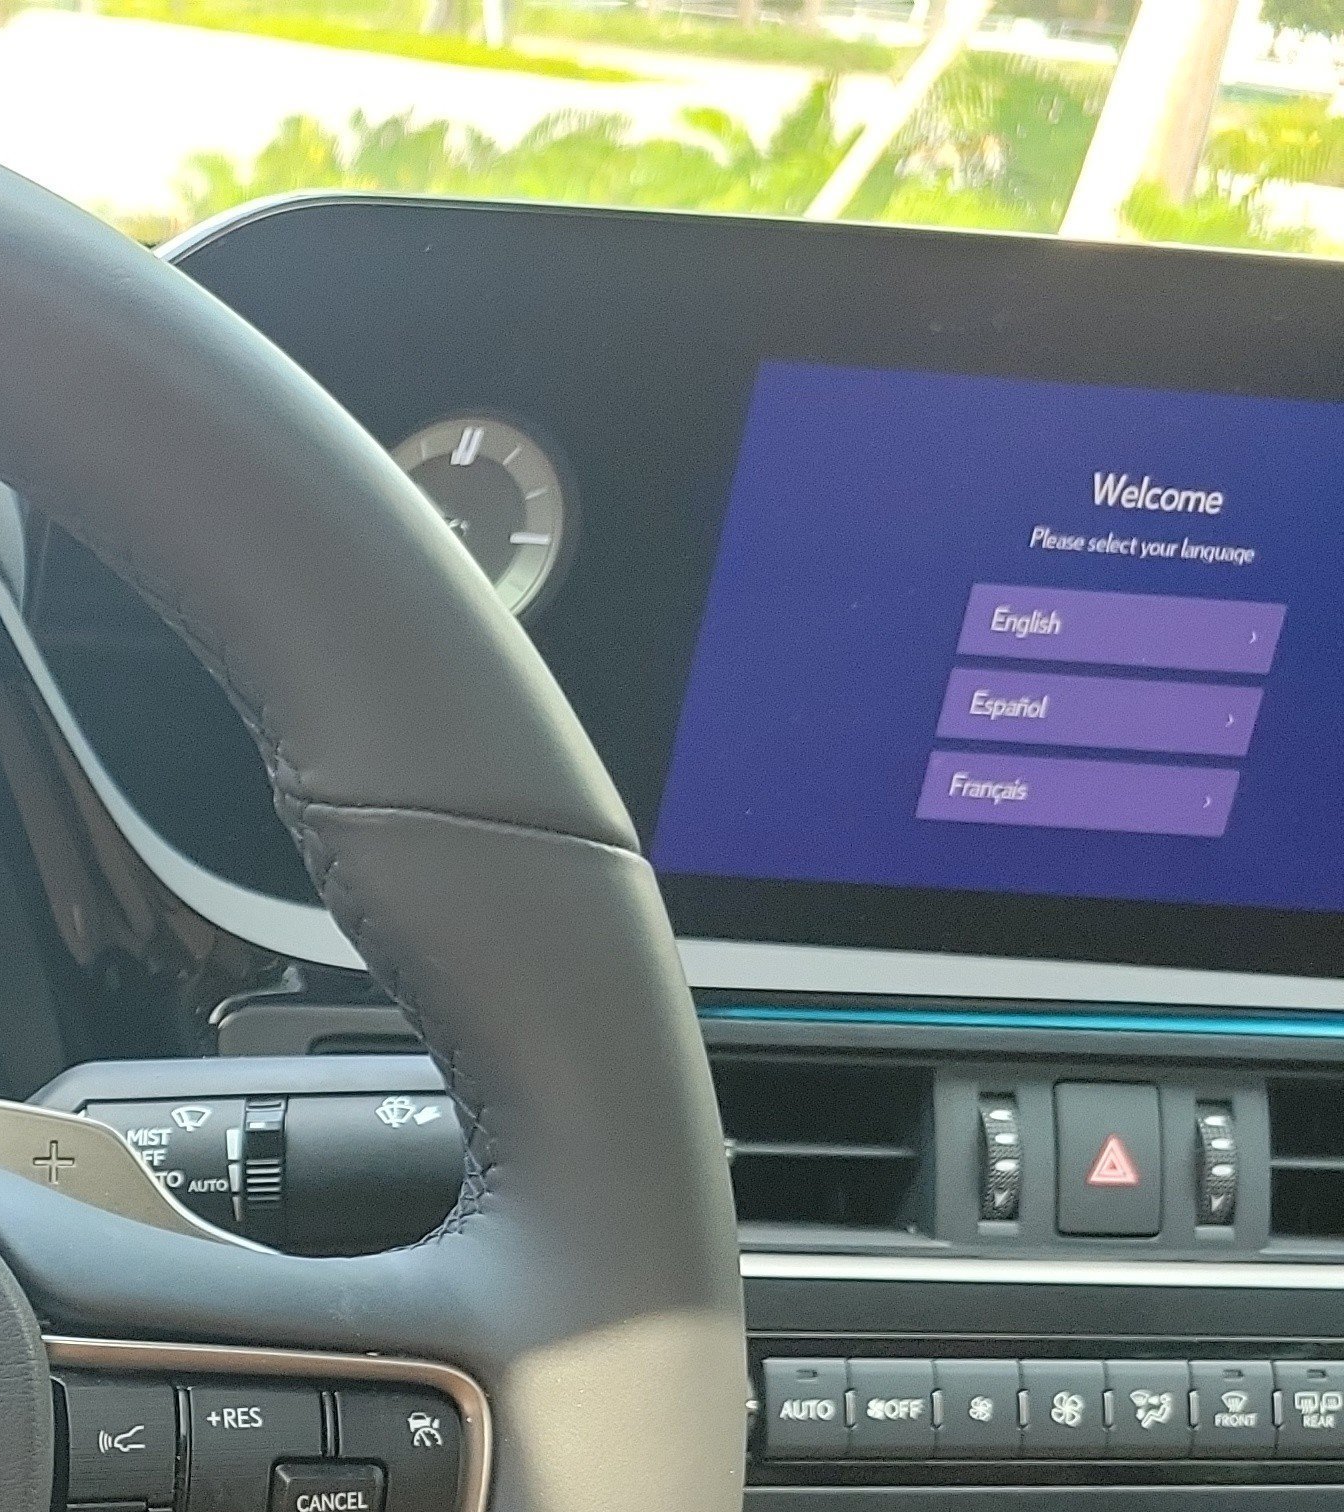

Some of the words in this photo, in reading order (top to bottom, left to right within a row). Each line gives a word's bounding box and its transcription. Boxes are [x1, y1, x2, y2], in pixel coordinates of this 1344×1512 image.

[1094, 471, 1223, 514] Welcome
[1029, 525, 1085, 550] Please
[1088, 532, 1137, 555] select
[1140, 539, 1178, 559] your
[1181, 537, 1255, 565] language
[991, 605, 1061, 638] English
[970, 688, 1050, 720] Español
[949, 771, 1027, 805] Français
[126, 1128, 171, 1146] MIST
[140, 1149, 166, 1166] FF
[154, 1170, 184, 1189] TO
[188, 1179, 229, 1194] AUTO
[780, 1399, 835, 1421] AUTO
[884, 1398, 924, 1420] OFF
[1214, 1412, 1258, 1428] FRONT
[1302, 1414, 1335, 1429] REAR
